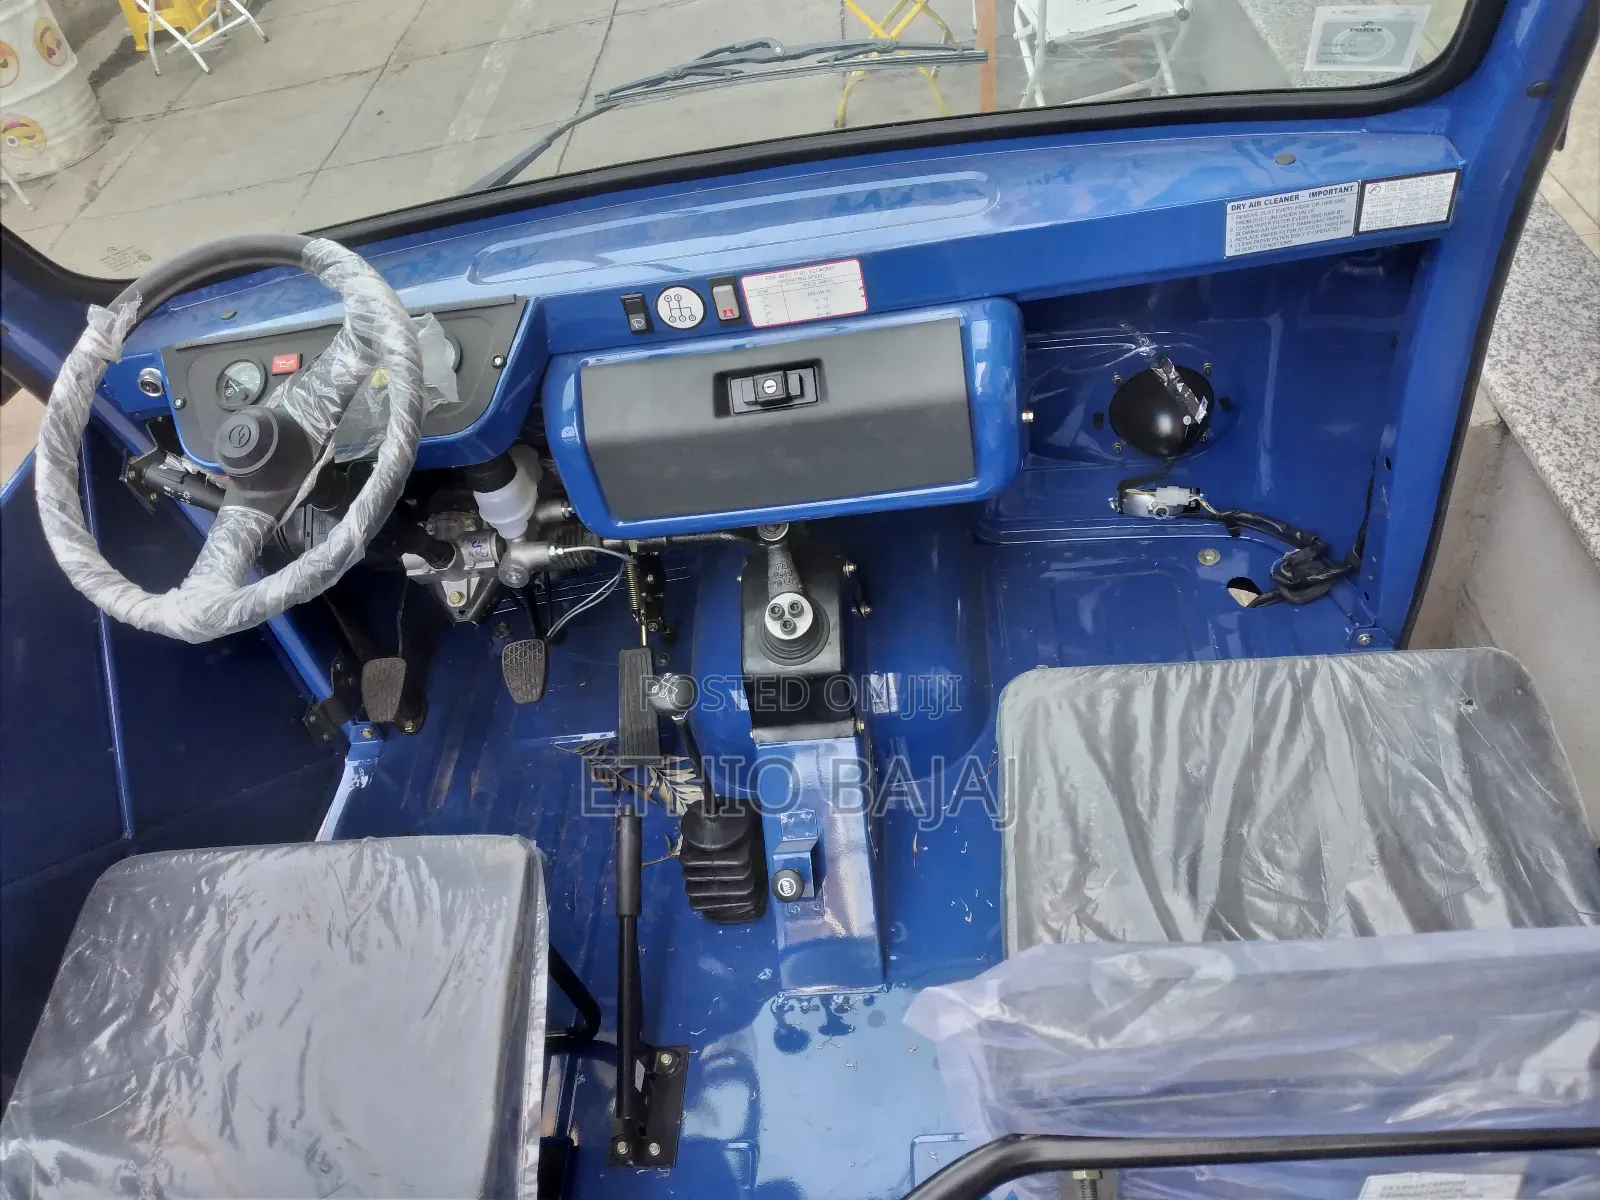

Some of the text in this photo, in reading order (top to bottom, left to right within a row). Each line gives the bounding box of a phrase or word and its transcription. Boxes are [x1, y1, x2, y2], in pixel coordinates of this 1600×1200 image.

[1231, 203, 1247, 212] DRY
[1248, 200, 1262, 209] AIR
[1263, 194, 1300, 206] CLEANER
[1308, 185, 1354, 199] IMPORTANT
[1235, 211, 1259, 220] REMOVE
[1259, 209, 1274, 217] DUST
[1275, 205, 1294, 213] EVERY
[1294, 203, 1311, 211] WEEK
[1235, 218, 1252, 226] FROM
[1267, 211, 1298, 220] UNLOADER
[1235, 223, 1254, 232] CLEAN
[1272, 217, 1291, 225] FILTER
[1291, 215, 1310, 223] EVERY
[1235, 228, 1260, 237] BLOWING
[1270, 222, 1295, 231] WITHOUT
[1296, 217, 1325, 227] DAMAGING
[1325, 214, 1344, 222] PAPER
[1234, 239, 1253, 248] CLEAN
[1253, 237, 1272, 245] PAPER
[1271, 234, 1290, 242] FILTER
[1290, 231, 1306, 239] DAILY
[1235, 234, 1260, 243] REPLACE
[1278, 227, 1297, 236] FILTER
[1305, 223, 1323, 232] EVERY
[1241, 243, 1259, 252] DUSTY
[1259, 239, 1294, 249] CONDITIONS
[777, 273, 826, 285] OPERATING SPEED
[808, 266, 835, 275] ECONOMY
[782, 880, 792, 894] STOP
